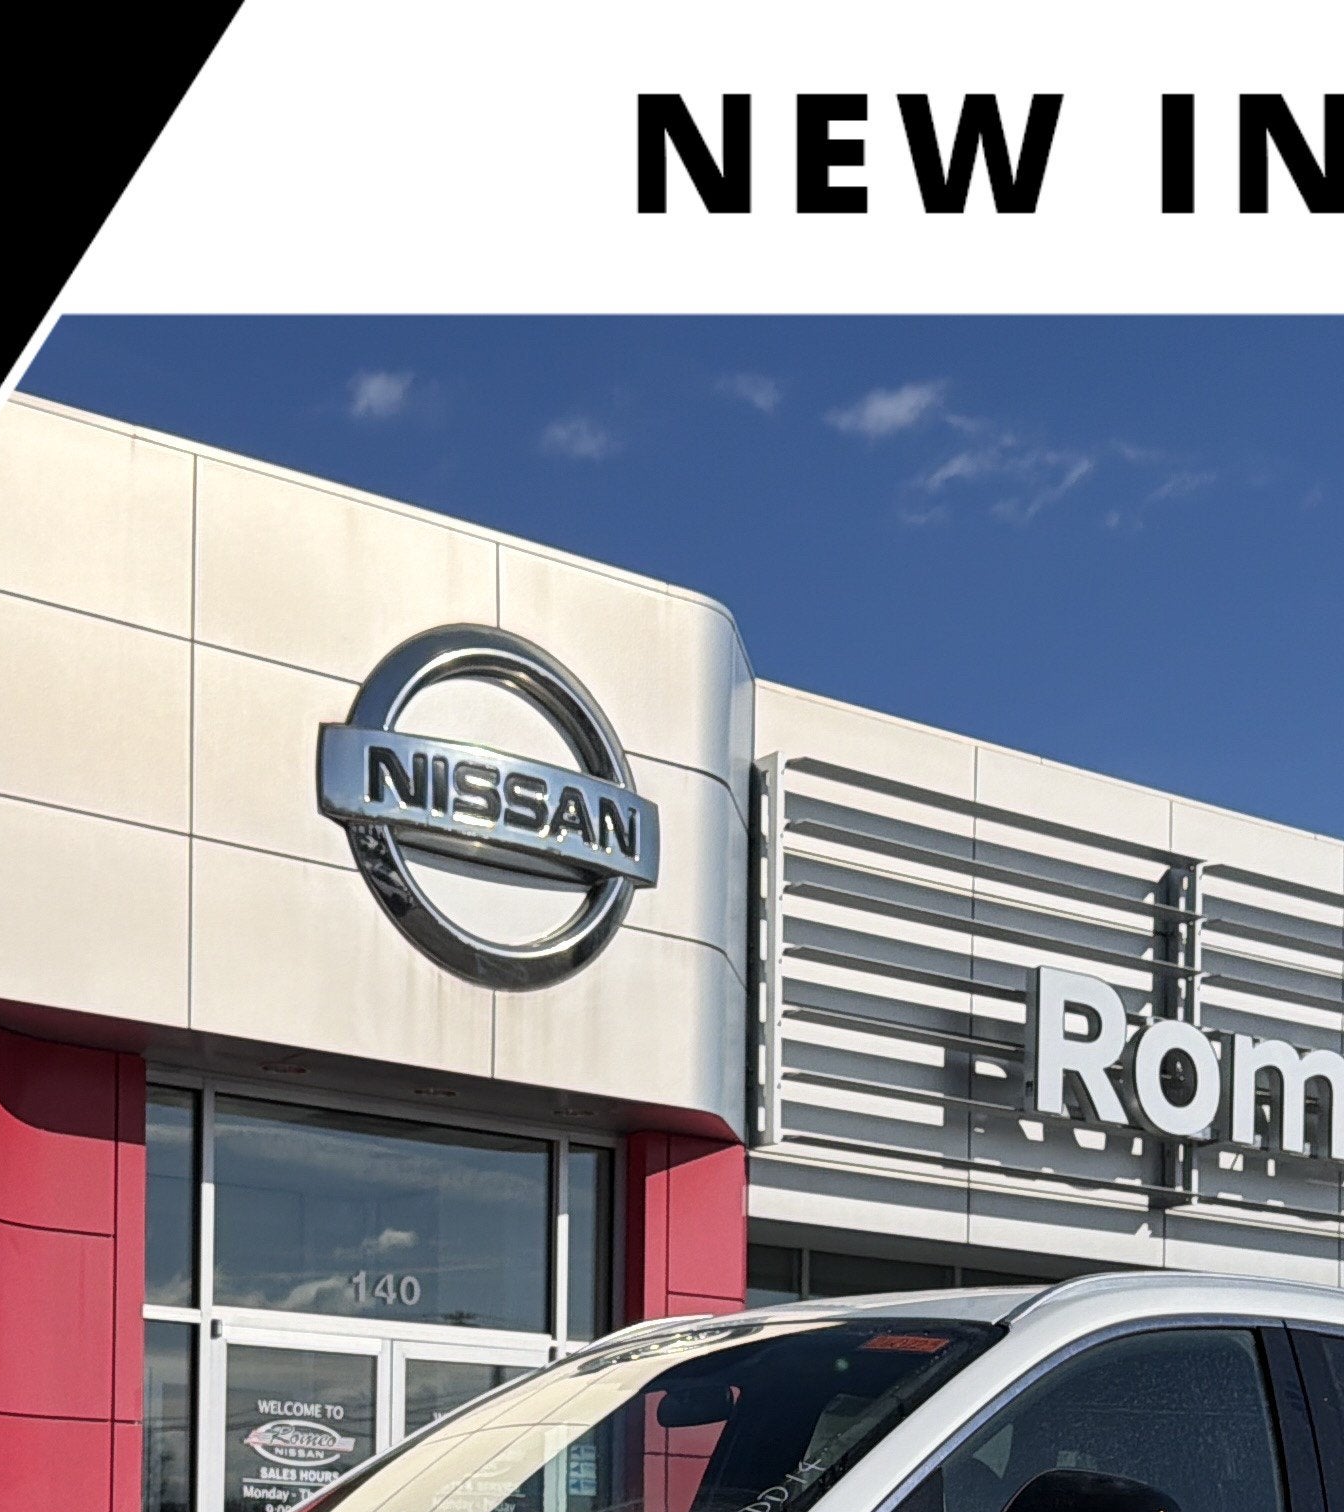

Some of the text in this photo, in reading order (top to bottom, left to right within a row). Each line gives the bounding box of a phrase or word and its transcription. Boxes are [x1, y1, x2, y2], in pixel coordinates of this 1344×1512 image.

[366, 745, 641, 862] NISSAN
[352, 1270, 421, 1306] 140
[257, 1399, 345, 1420] WELCOME TO
[274, 1446, 325, 1459] NISSAN
[260, 1466, 297, 1481] SALES
[243, 1485, 289, 1501] Monday
